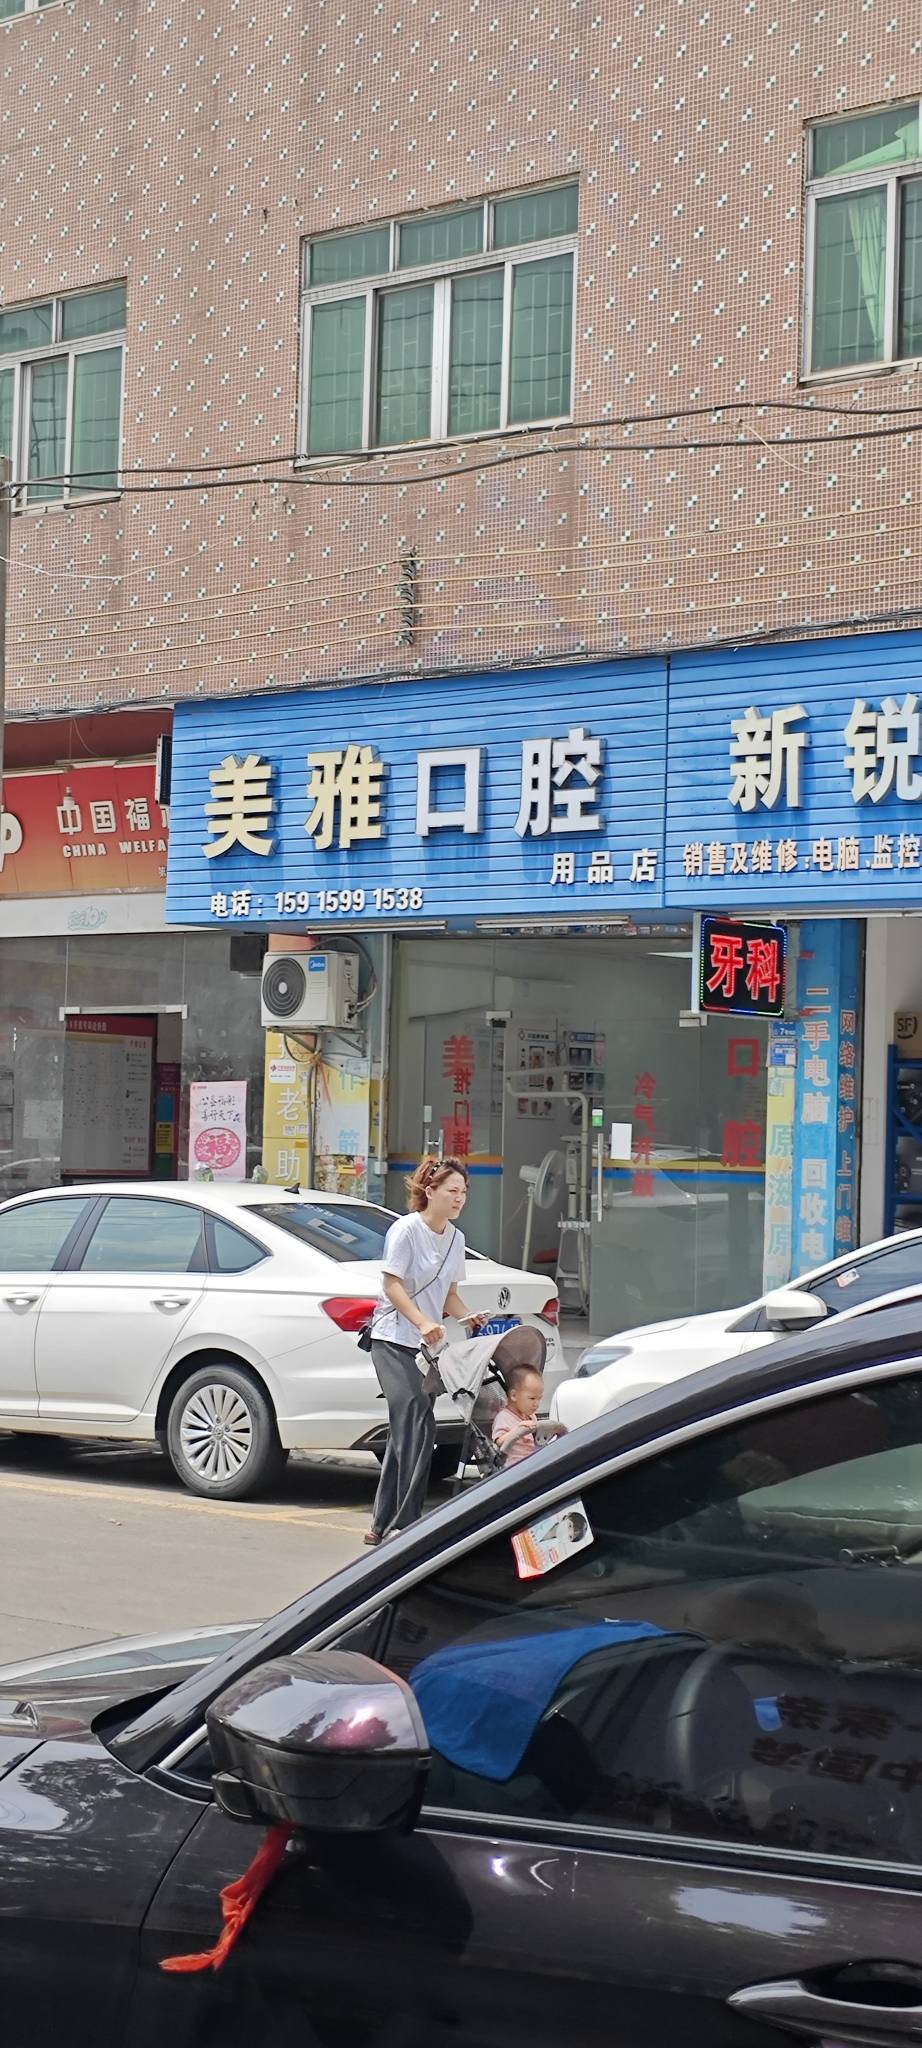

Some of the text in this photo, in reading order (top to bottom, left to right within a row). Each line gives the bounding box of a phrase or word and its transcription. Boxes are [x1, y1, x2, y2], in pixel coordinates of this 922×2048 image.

[728, 693, 922, 812] 新锐
[56, 797, 170, 836] 中国福
[201, 727, 607, 860] 美雅口腔
[62, 843, 107, 858] CHINA
[549, 847, 658, 885] 用品店
[275, 891, 309, 914] 159
[317, 889, 365, 912] 1599
[372, 887, 423, 910] 1538
[706, 934, 780, 1003] 牙科
[897, 1017, 913, 1032] SF
[835, 1009, 857, 1252] 网络维护 上门维
[799, 1158, 829, 1273] 回收电
